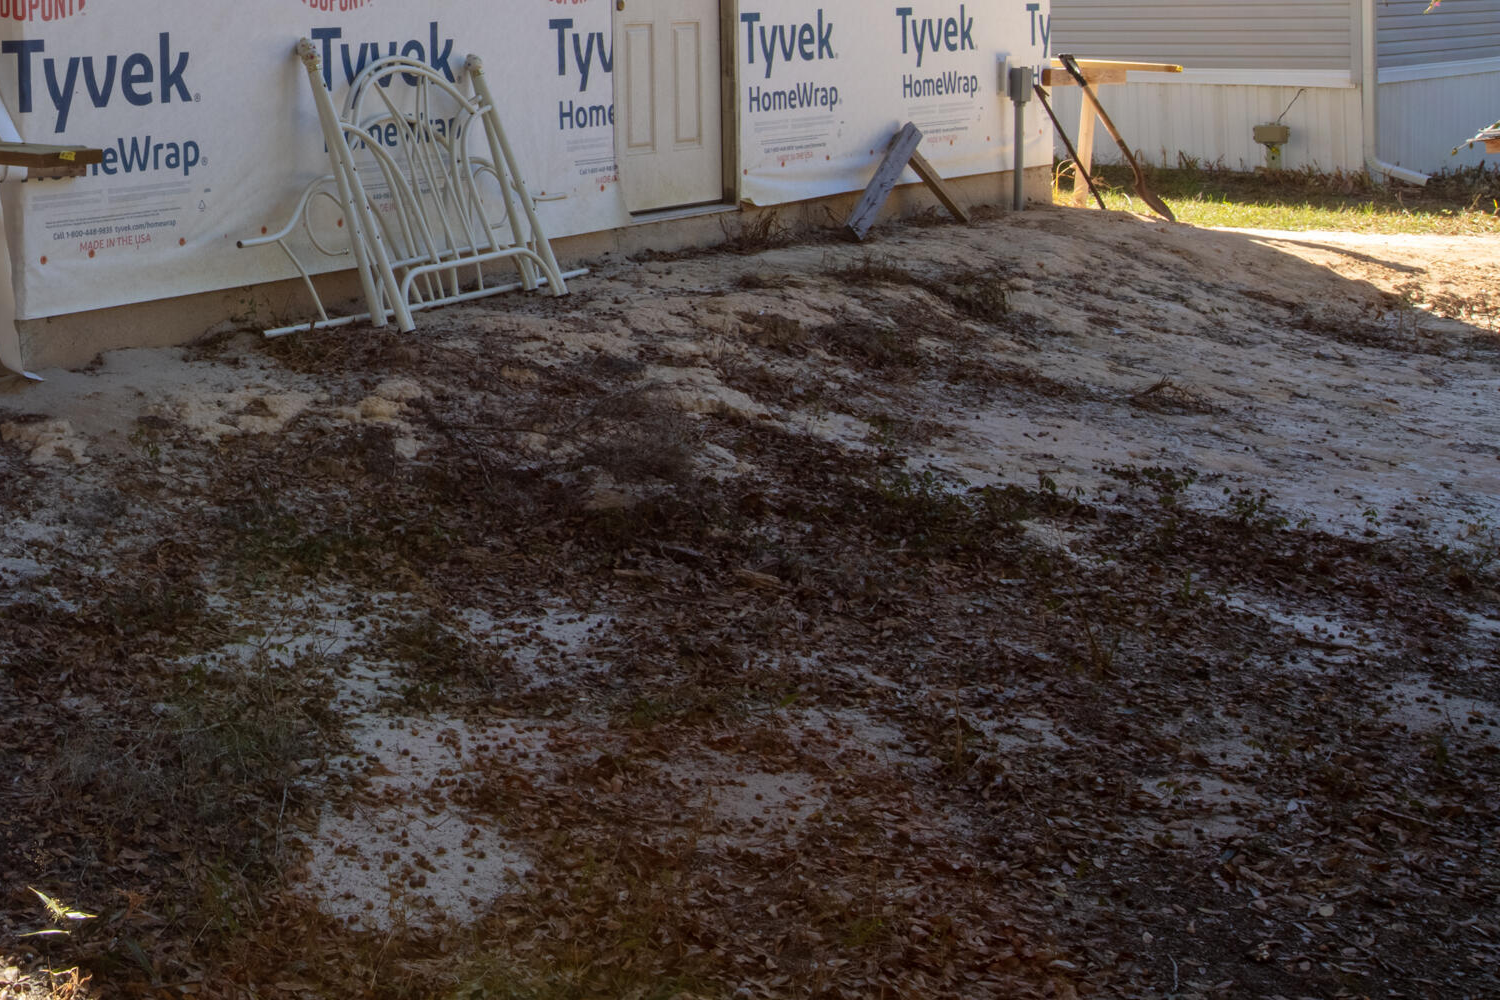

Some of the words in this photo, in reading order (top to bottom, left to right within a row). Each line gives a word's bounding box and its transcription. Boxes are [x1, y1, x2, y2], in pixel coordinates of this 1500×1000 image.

[549, 18, 613, 92] Tyv
[740, 9, 834, 79] Tyvek
[896, 4, 974, 68] Tyvek
[1, 32, 193, 134] Tyvek
[749, 82, 838, 113] HomeWrap
[903, 71, 978, 98] HomeWrap
[53, 232, 64, 240] Call
[115, 220, 177, 234] tyvek.com/homewrap
[80, 240, 104, 252] MADE
[117, 236, 132, 246] THE
[135, 233, 151, 245] USA
